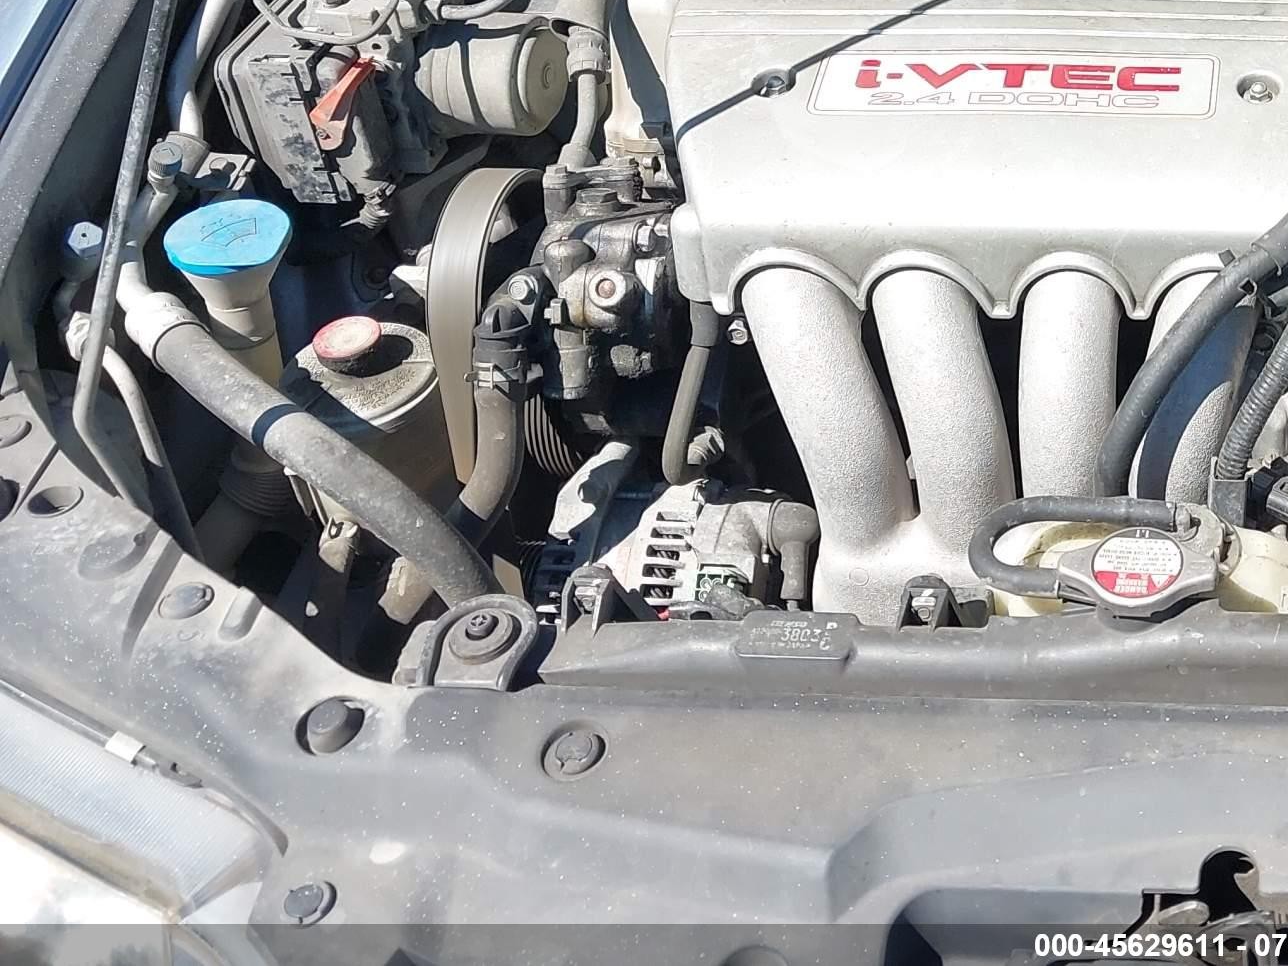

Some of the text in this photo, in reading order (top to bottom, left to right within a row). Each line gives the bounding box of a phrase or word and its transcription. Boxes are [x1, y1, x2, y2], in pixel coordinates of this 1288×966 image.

[855, 59, 1182, 91] i-VTEC
[867, 91, 1160, 109] 2.4 DOHC
